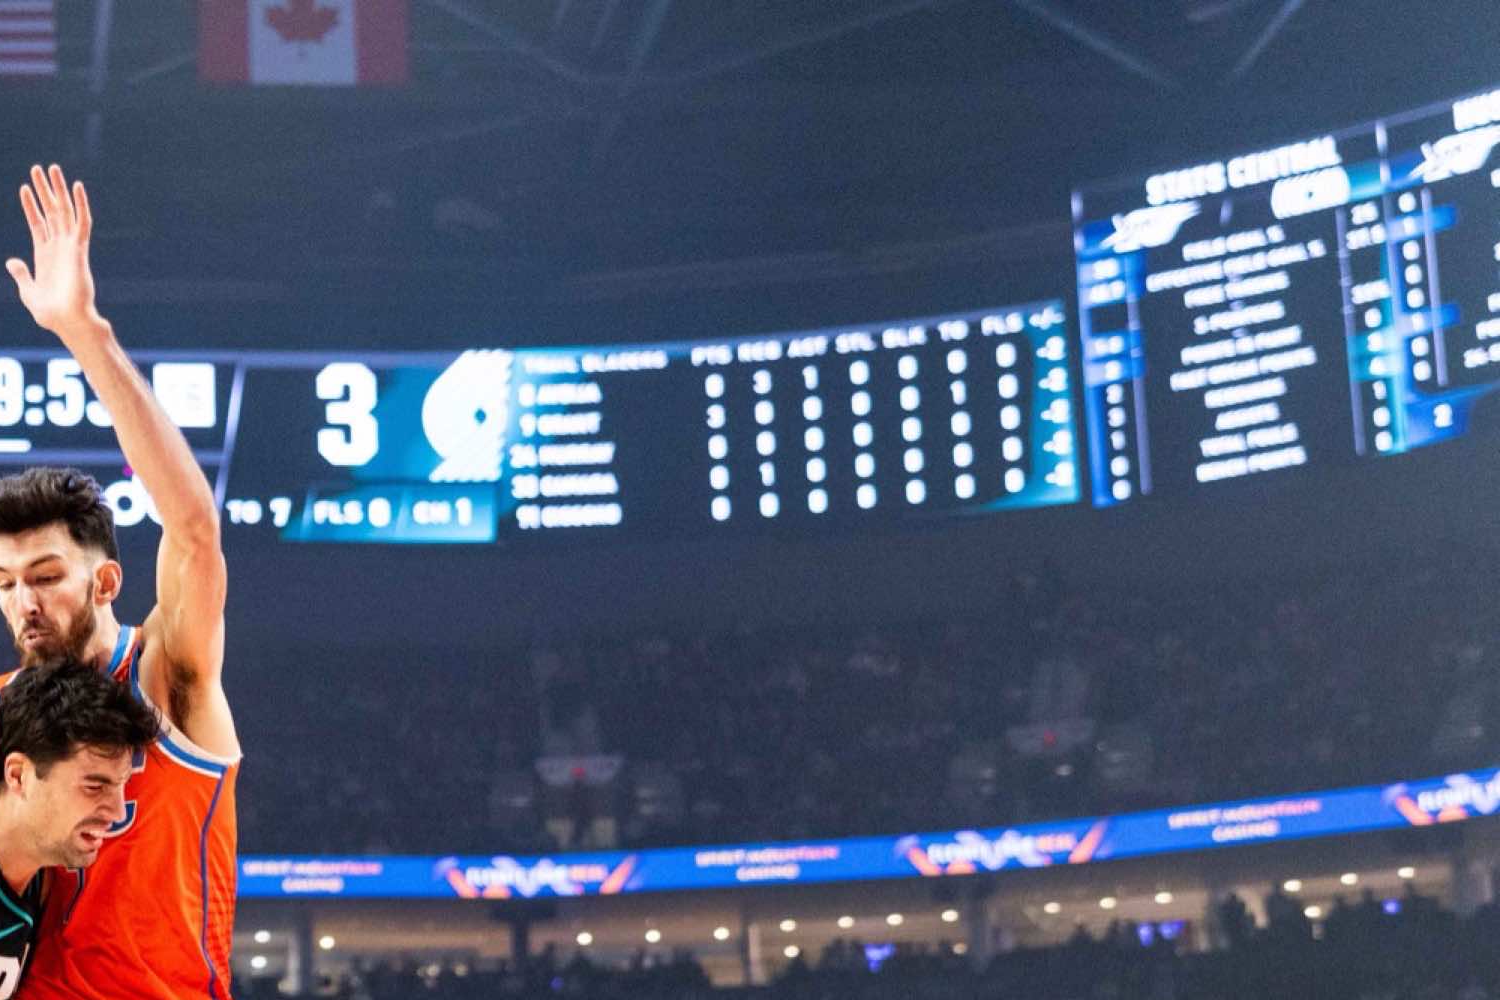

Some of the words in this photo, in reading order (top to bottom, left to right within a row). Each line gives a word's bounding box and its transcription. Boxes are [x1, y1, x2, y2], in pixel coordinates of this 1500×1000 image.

[316, 362, 377, 466] 3
[269, 498, 291, 527] 7
[456, 498, 472, 526] 1
